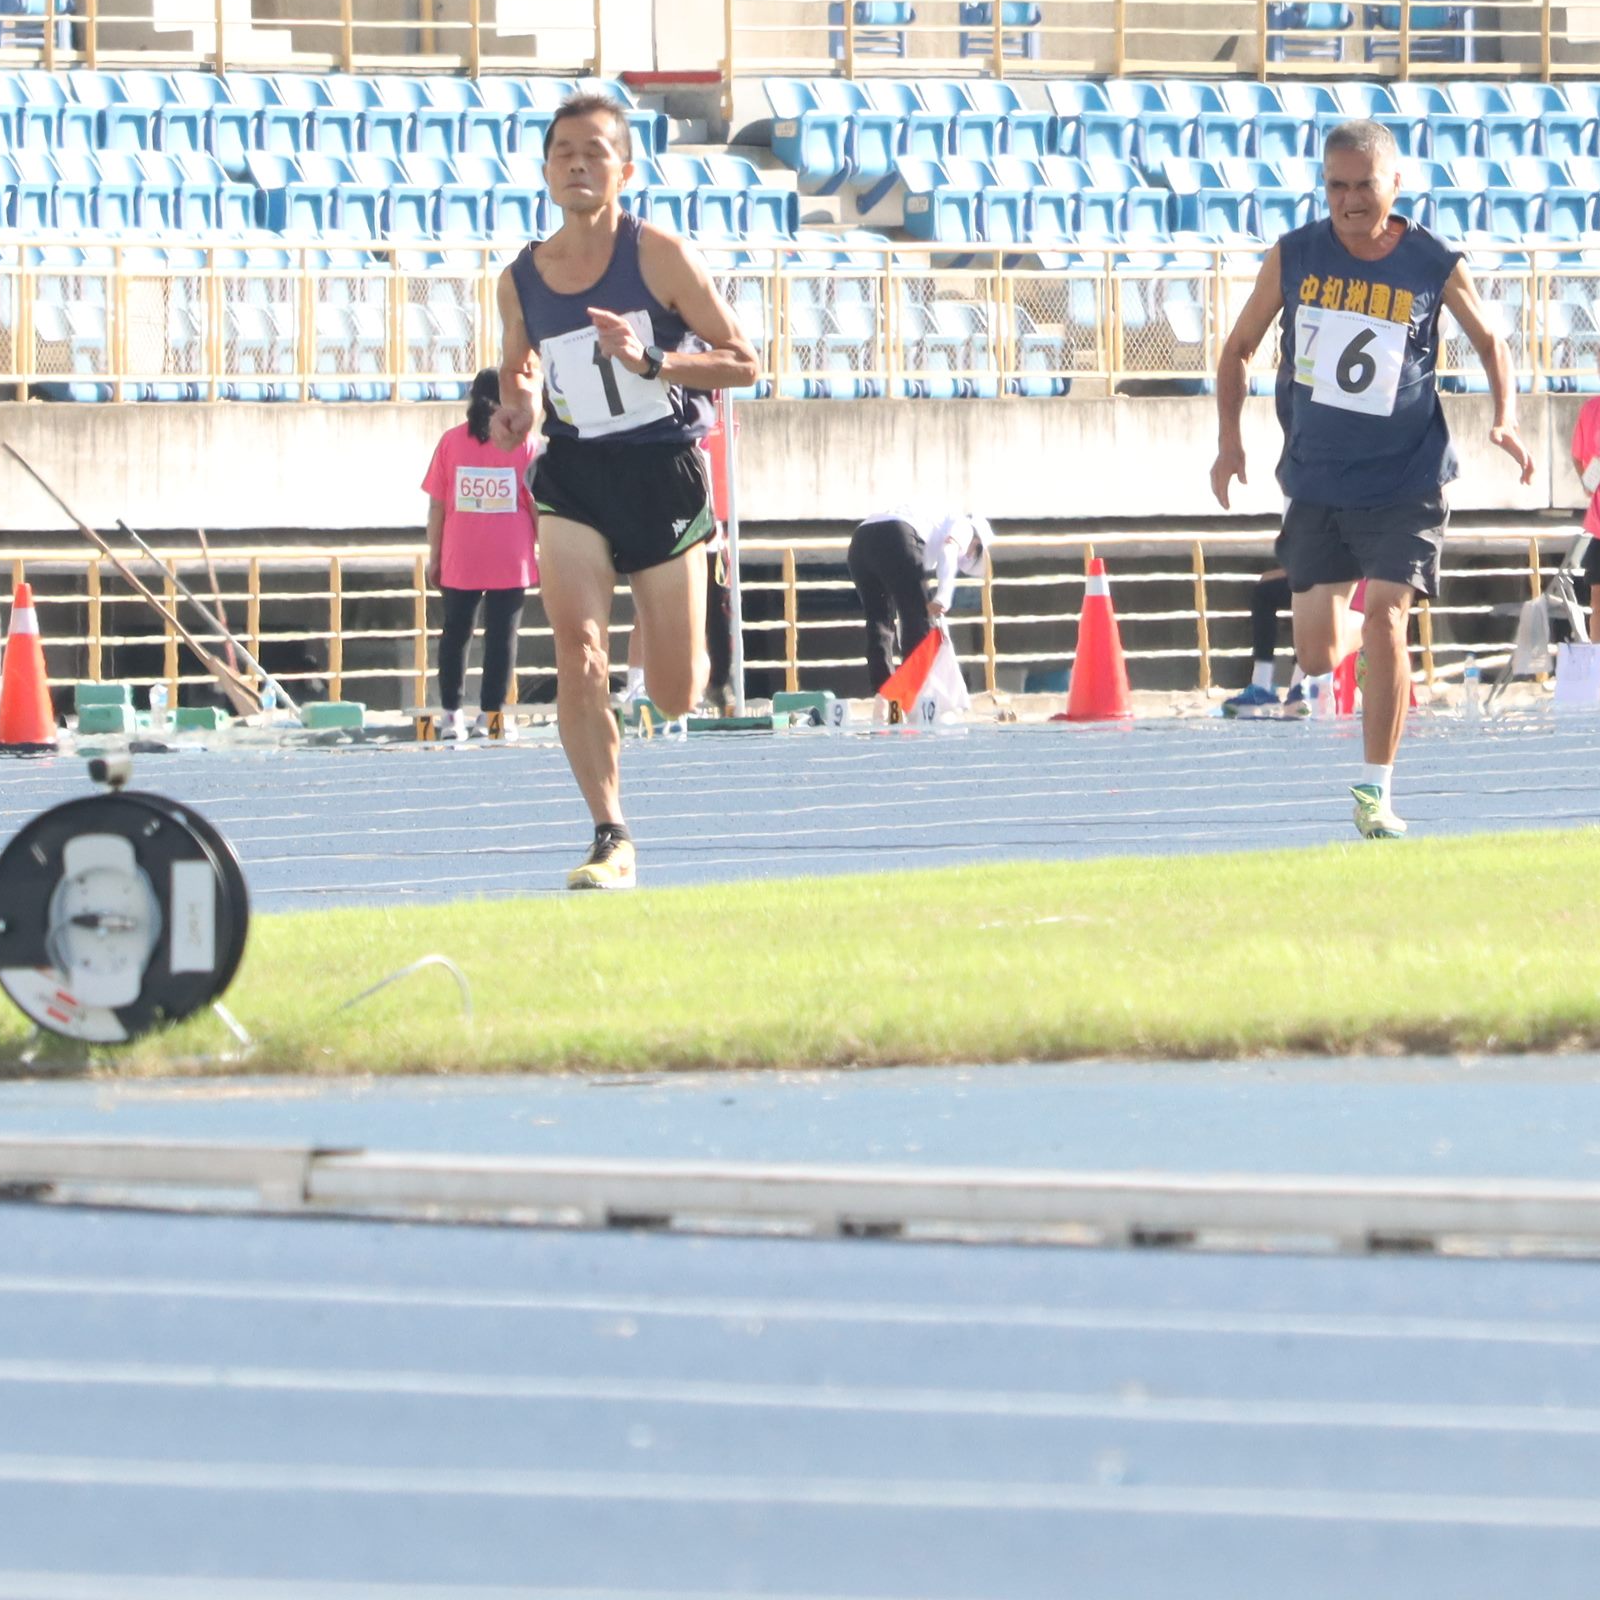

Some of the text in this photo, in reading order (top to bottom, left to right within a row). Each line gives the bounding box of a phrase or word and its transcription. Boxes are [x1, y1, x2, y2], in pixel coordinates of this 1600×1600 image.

[592, 340, 626, 417] 1
[1336, 328, 1378, 394] 6
[461, 477, 510, 497] 6505
[420, 715, 431, 741] 7
